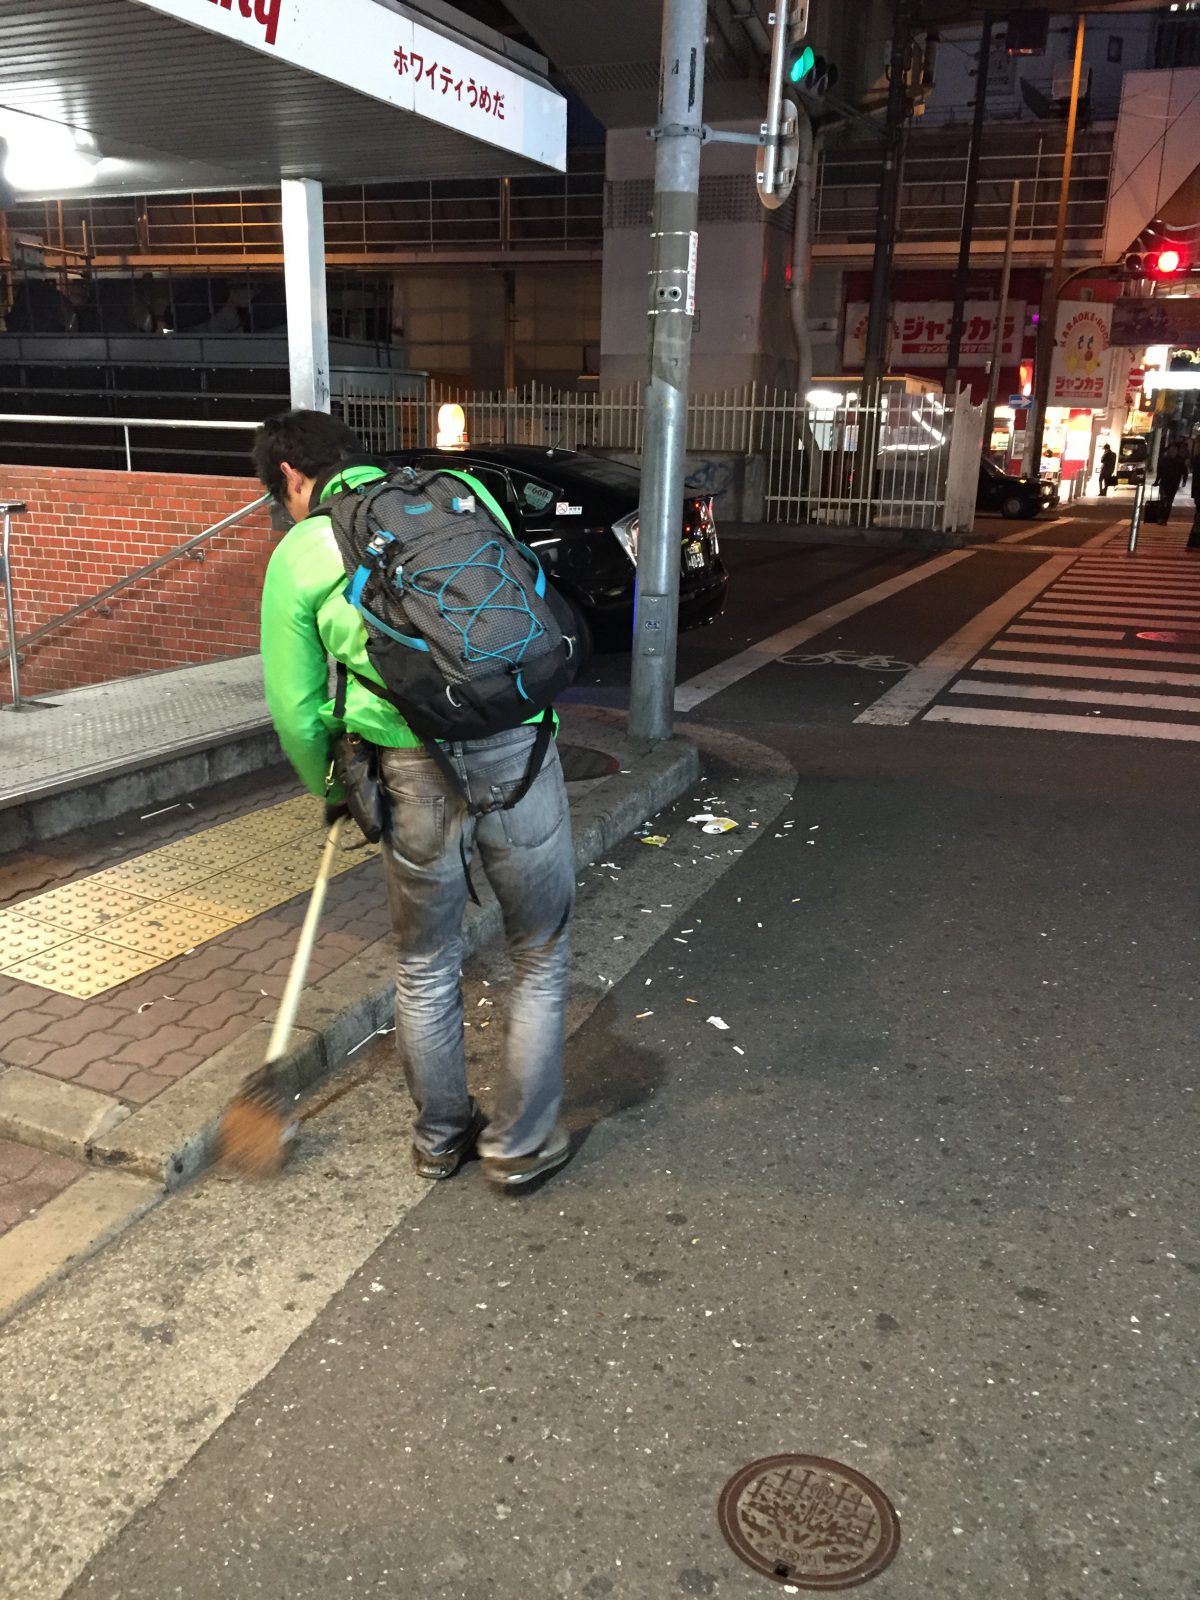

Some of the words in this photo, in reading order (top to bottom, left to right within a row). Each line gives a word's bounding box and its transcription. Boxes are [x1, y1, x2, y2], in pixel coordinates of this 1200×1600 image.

[394, 46, 505, 120] ホワイティうめだ
[1056, 376, 1104, 390] ジャンカラ
